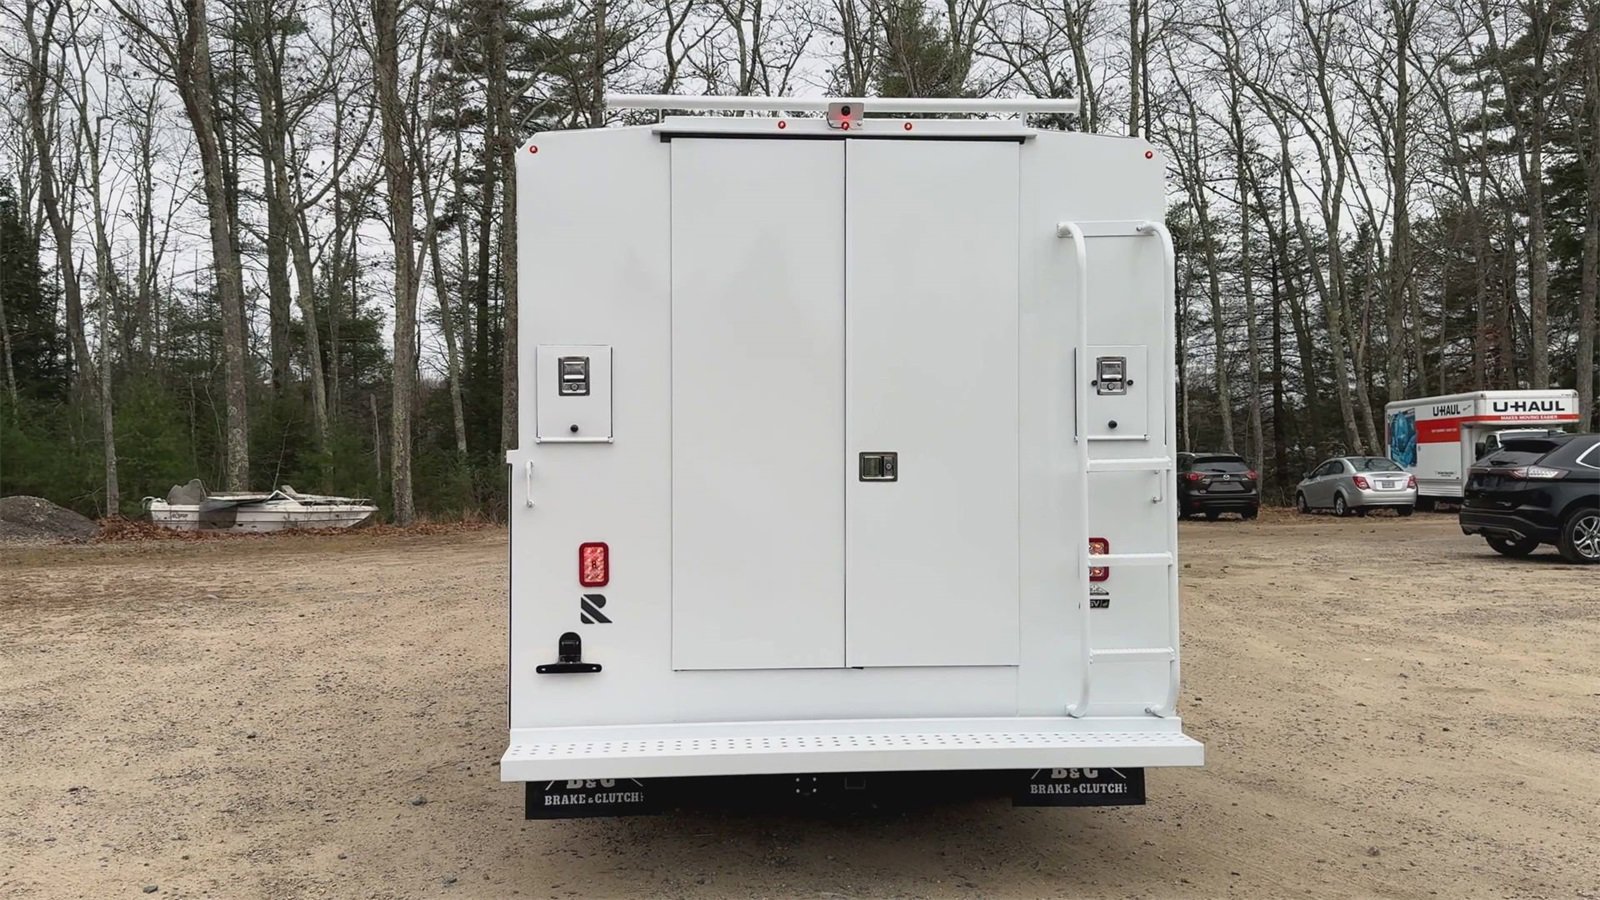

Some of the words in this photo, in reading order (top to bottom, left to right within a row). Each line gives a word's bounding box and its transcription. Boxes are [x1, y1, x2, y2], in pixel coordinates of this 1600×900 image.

[1432, 404, 1461, 417] U-HAUL
[1493, 400, 1565, 412] U-HAUL
[1030, 784, 1071, 794] BRAKE
[1079, 783, 1123, 794] CLUTCH
[544, 794, 586, 806] BRAKE
[594, 791, 639, 804] CLUTCH
